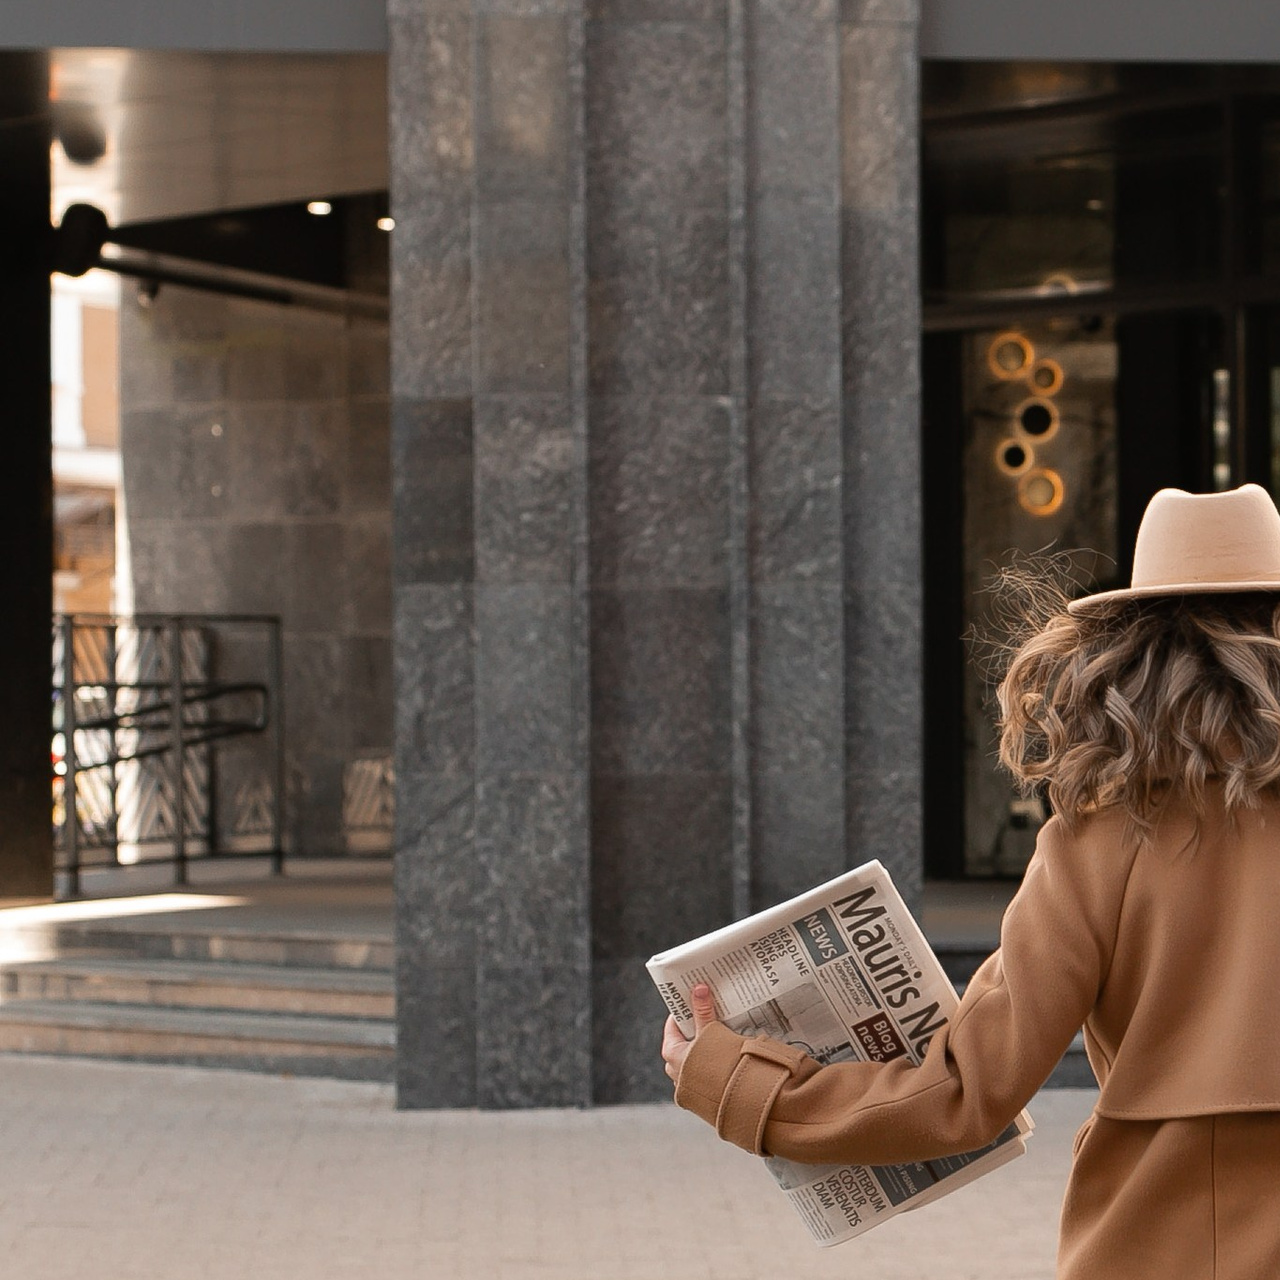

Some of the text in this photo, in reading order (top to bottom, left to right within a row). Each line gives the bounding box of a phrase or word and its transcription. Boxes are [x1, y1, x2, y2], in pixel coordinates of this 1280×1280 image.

[758, 936, 779, 962] ISING
[767, 931, 788, 958] DURS
[776, 927, 810, 977] HEADLINE
[804, 914, 838, 959] NEWS
[832, 886, 922, 1008] Mauris
[749, 942, 780, 987] ATORASA
[665, 982, 693, 1020] ANOTHER
[857, 1026, 884, 1061] news
[873, 1020, 897, 1053] Blog
[812, 1182, 835, 1209] DIAM
[826, 1175, 862, 1228] VENENATIS
[838, 1169, 867, 1208] COSTUR
